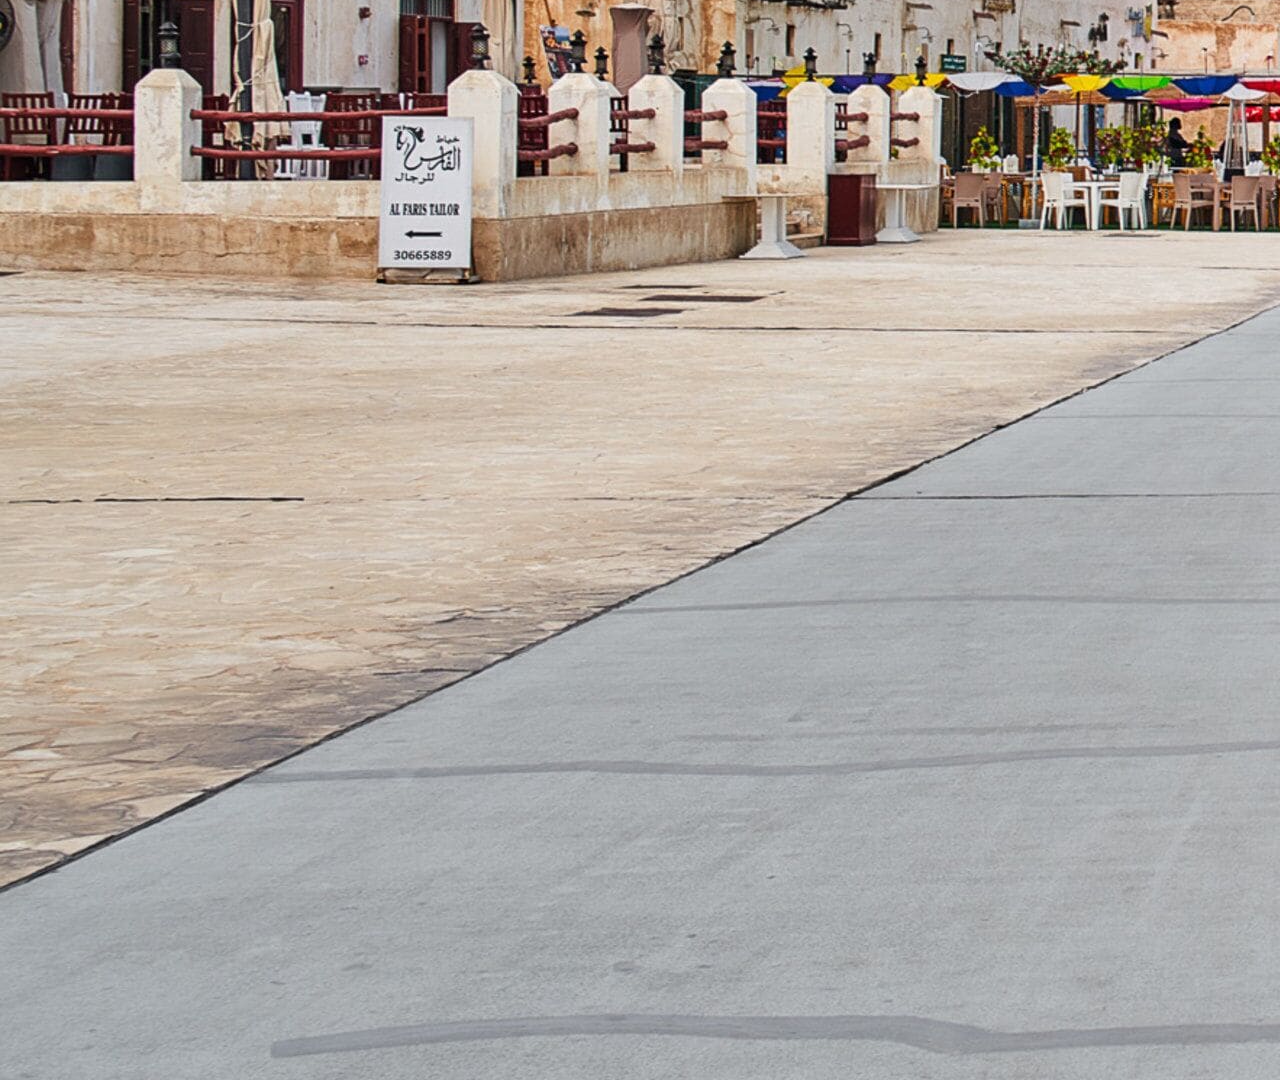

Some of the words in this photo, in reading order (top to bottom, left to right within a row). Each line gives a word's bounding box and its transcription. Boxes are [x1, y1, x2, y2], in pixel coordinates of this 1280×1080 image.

[394, 172, 435, 185] للرجال
[389, 203, 400, 216] AL
[402, 203, 427, 216] FARIS
[429, 203, 460, 216] TAILOR
[393, 250, 452, 261] 30665889
